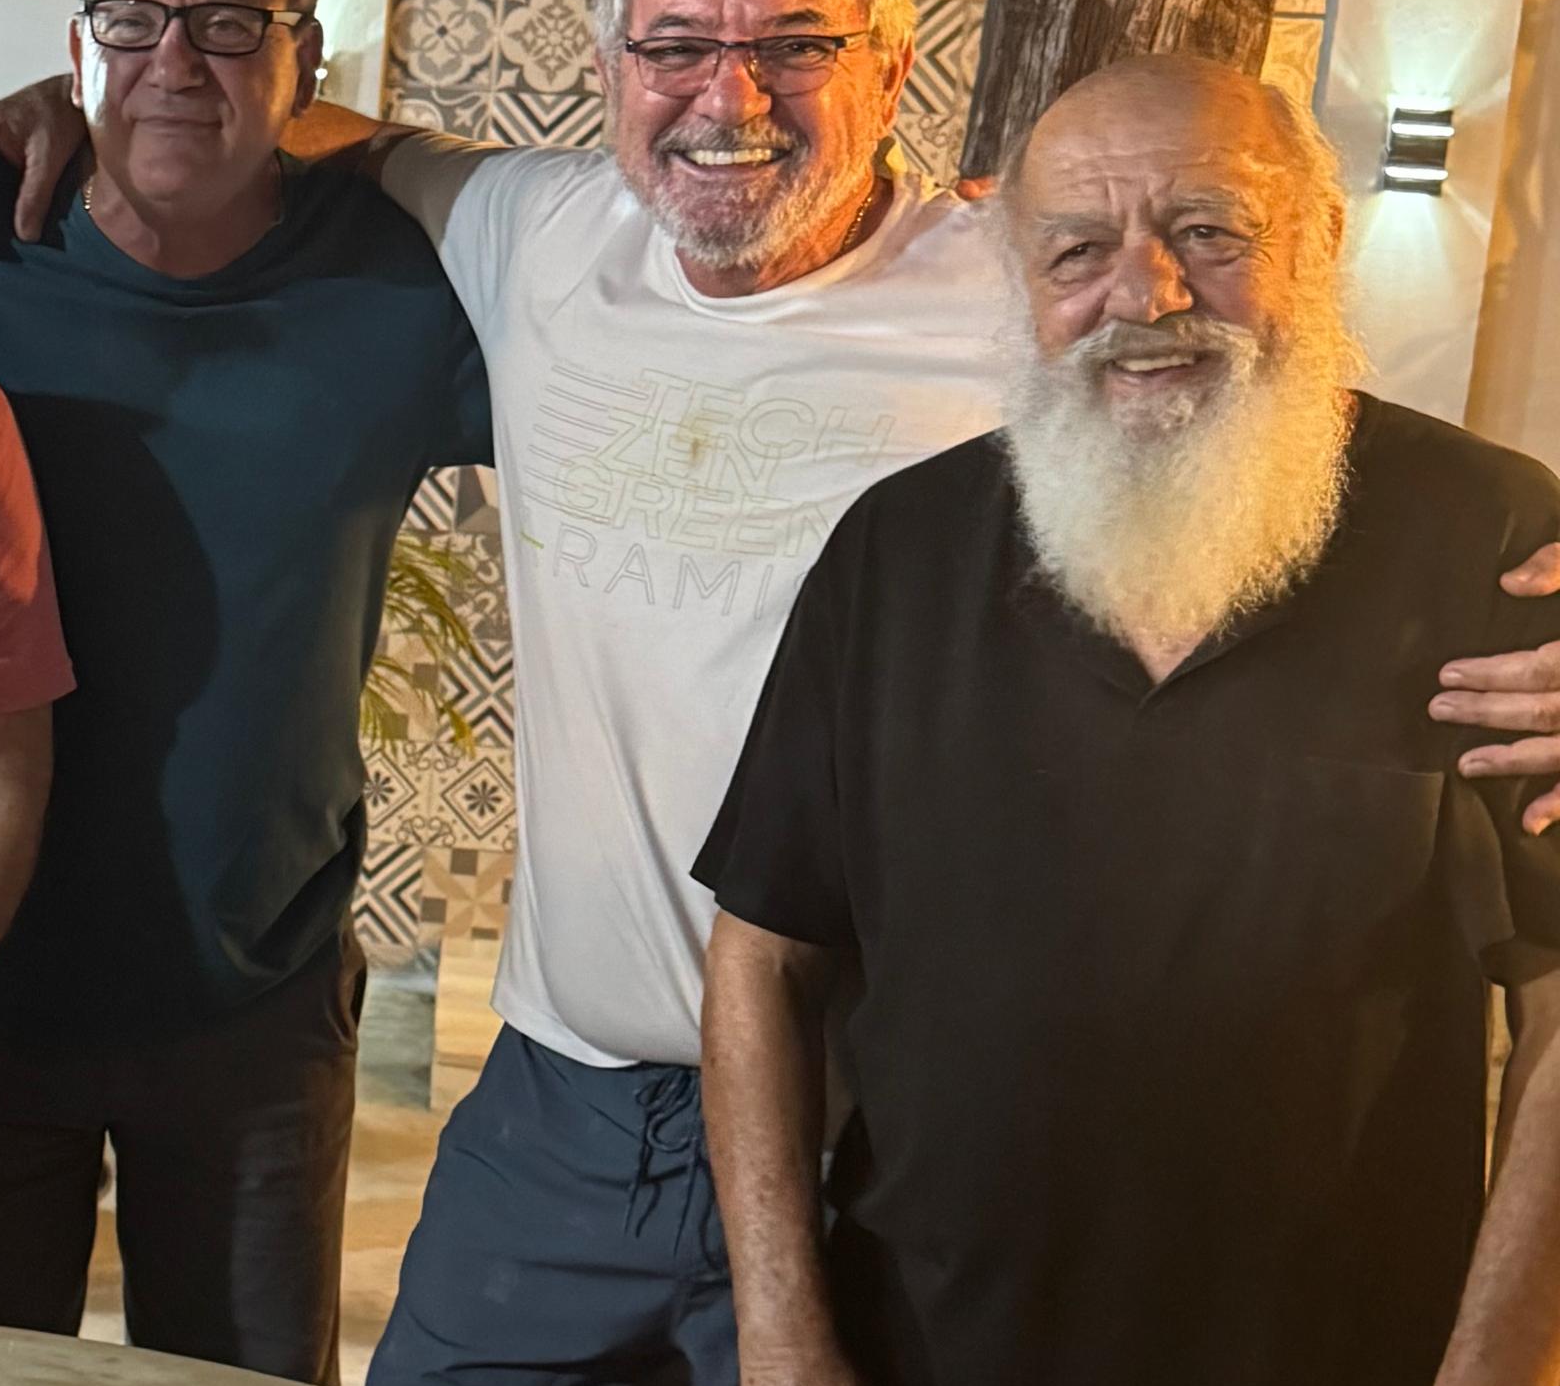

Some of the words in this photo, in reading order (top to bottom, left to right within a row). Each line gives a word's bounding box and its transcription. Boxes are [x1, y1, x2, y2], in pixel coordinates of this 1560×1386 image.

[595, 406, 782, 502] ZEN
[640, 368, 897, 468] TECH
[551, 522, 807, 621] RAMI
